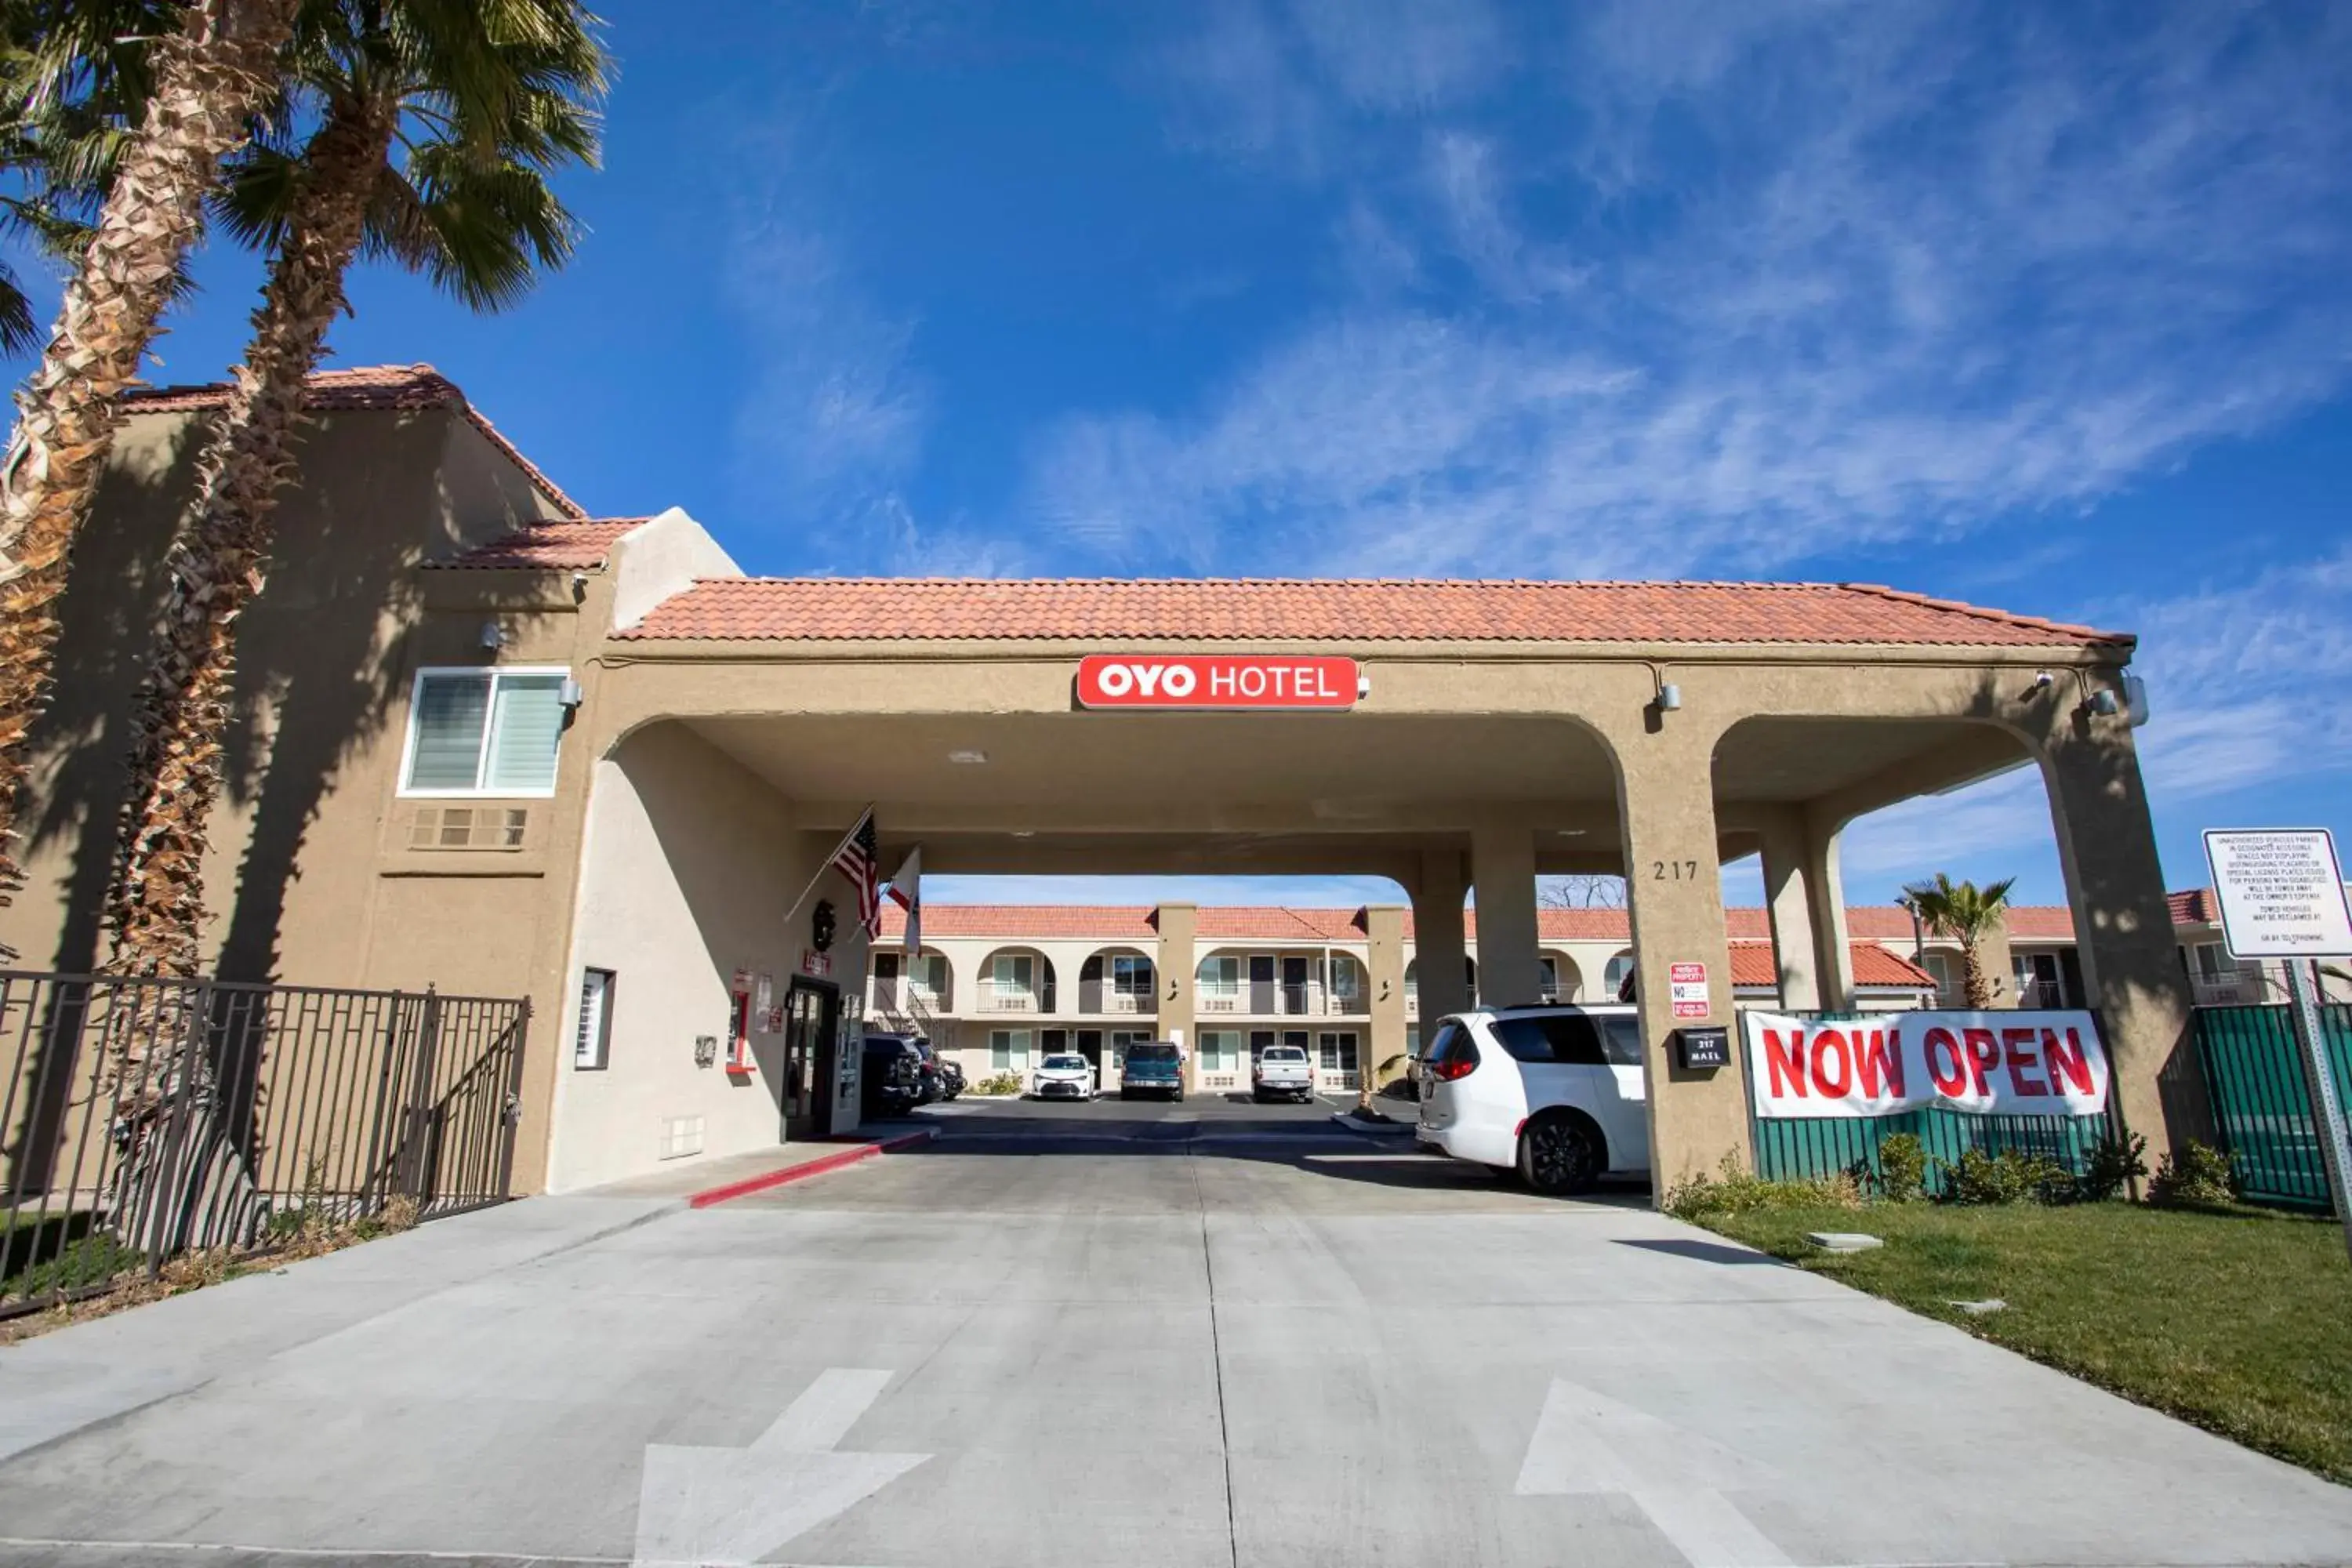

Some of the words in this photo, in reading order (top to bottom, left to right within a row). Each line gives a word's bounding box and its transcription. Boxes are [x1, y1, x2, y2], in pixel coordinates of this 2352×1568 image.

[1098, 664, 1196, 697] OYO
[1210, 666, 1338, 697] HOTEL
[1653, 861, 1697, 880] 217
[1699, 1040, 1715, 1048] 217
[1691, 1052, 1721, 1061] MAIL
[1762, 1029, 1906, 1099] NOW
[1923, 1027, 2095, 1098] OPEN
